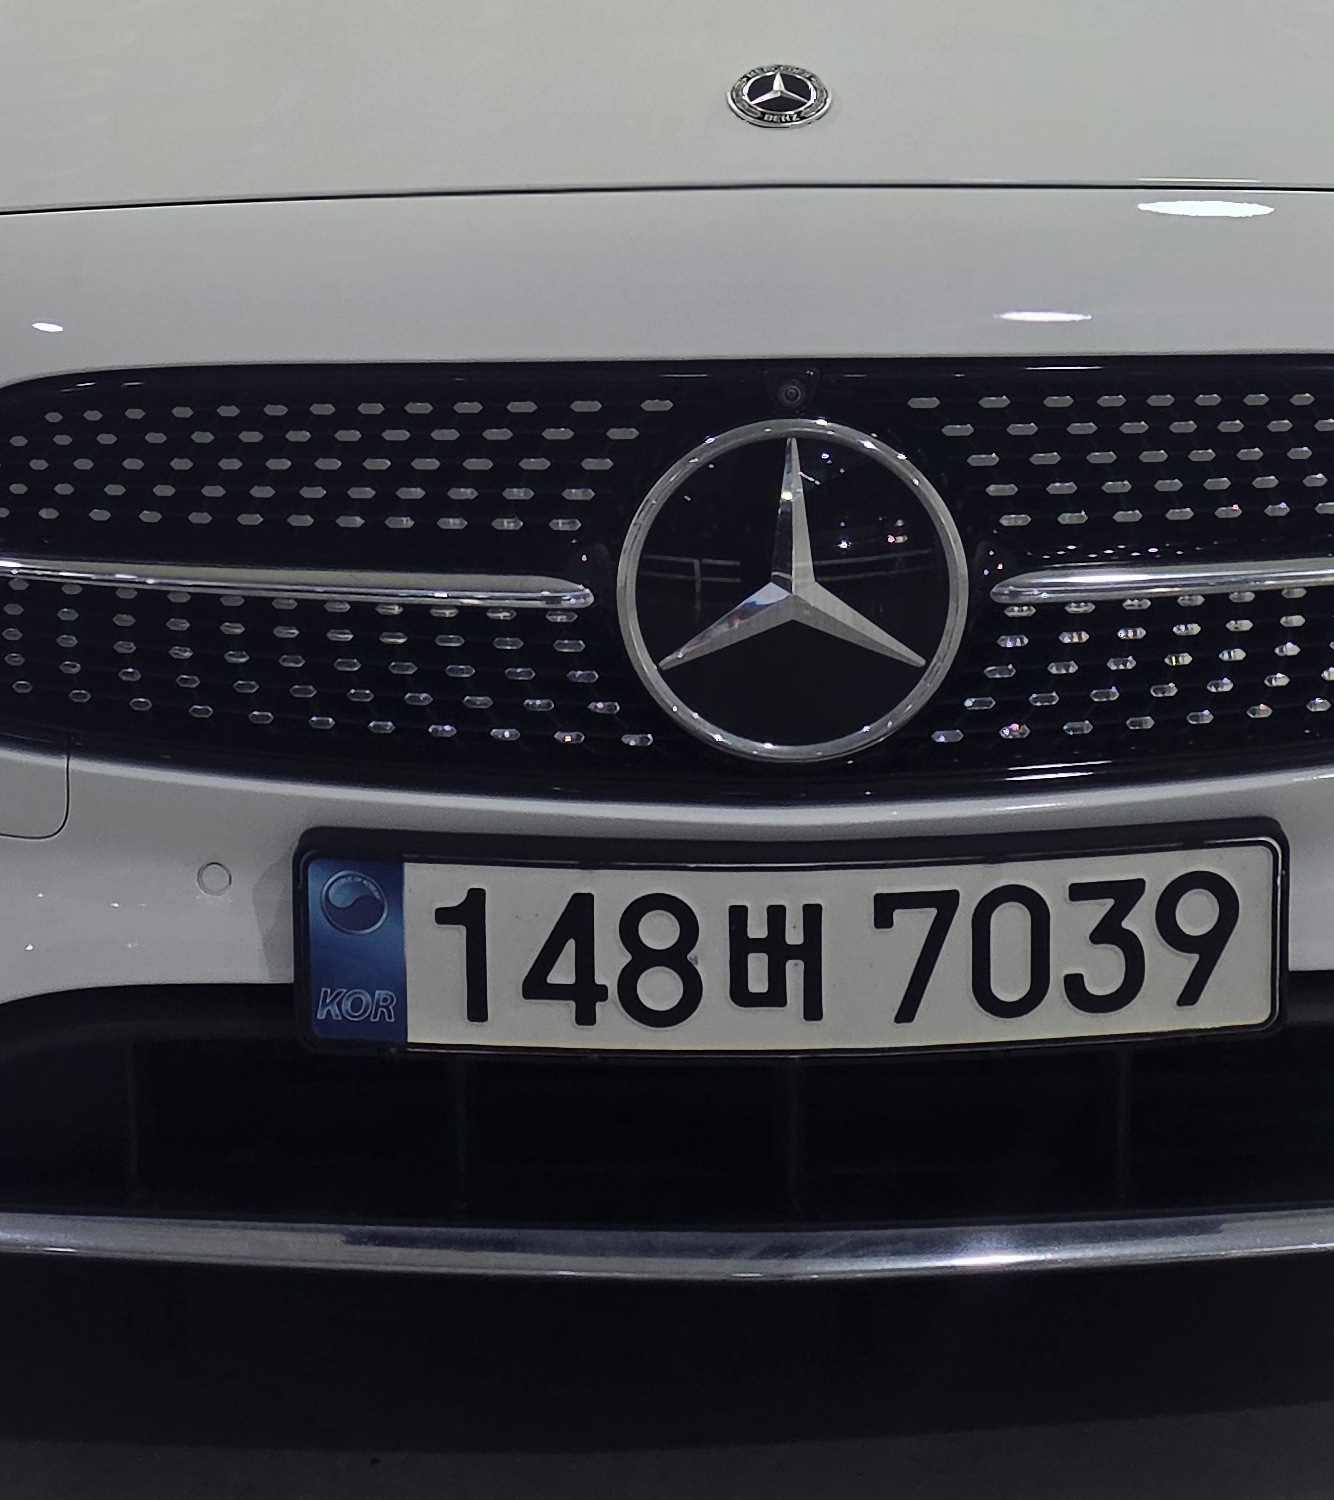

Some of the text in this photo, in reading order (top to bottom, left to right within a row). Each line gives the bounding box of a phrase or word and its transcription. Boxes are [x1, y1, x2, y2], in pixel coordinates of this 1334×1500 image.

[434, 870, 1240, 1029] 148버 7039
[316, 987, 397, 1023] KOR
